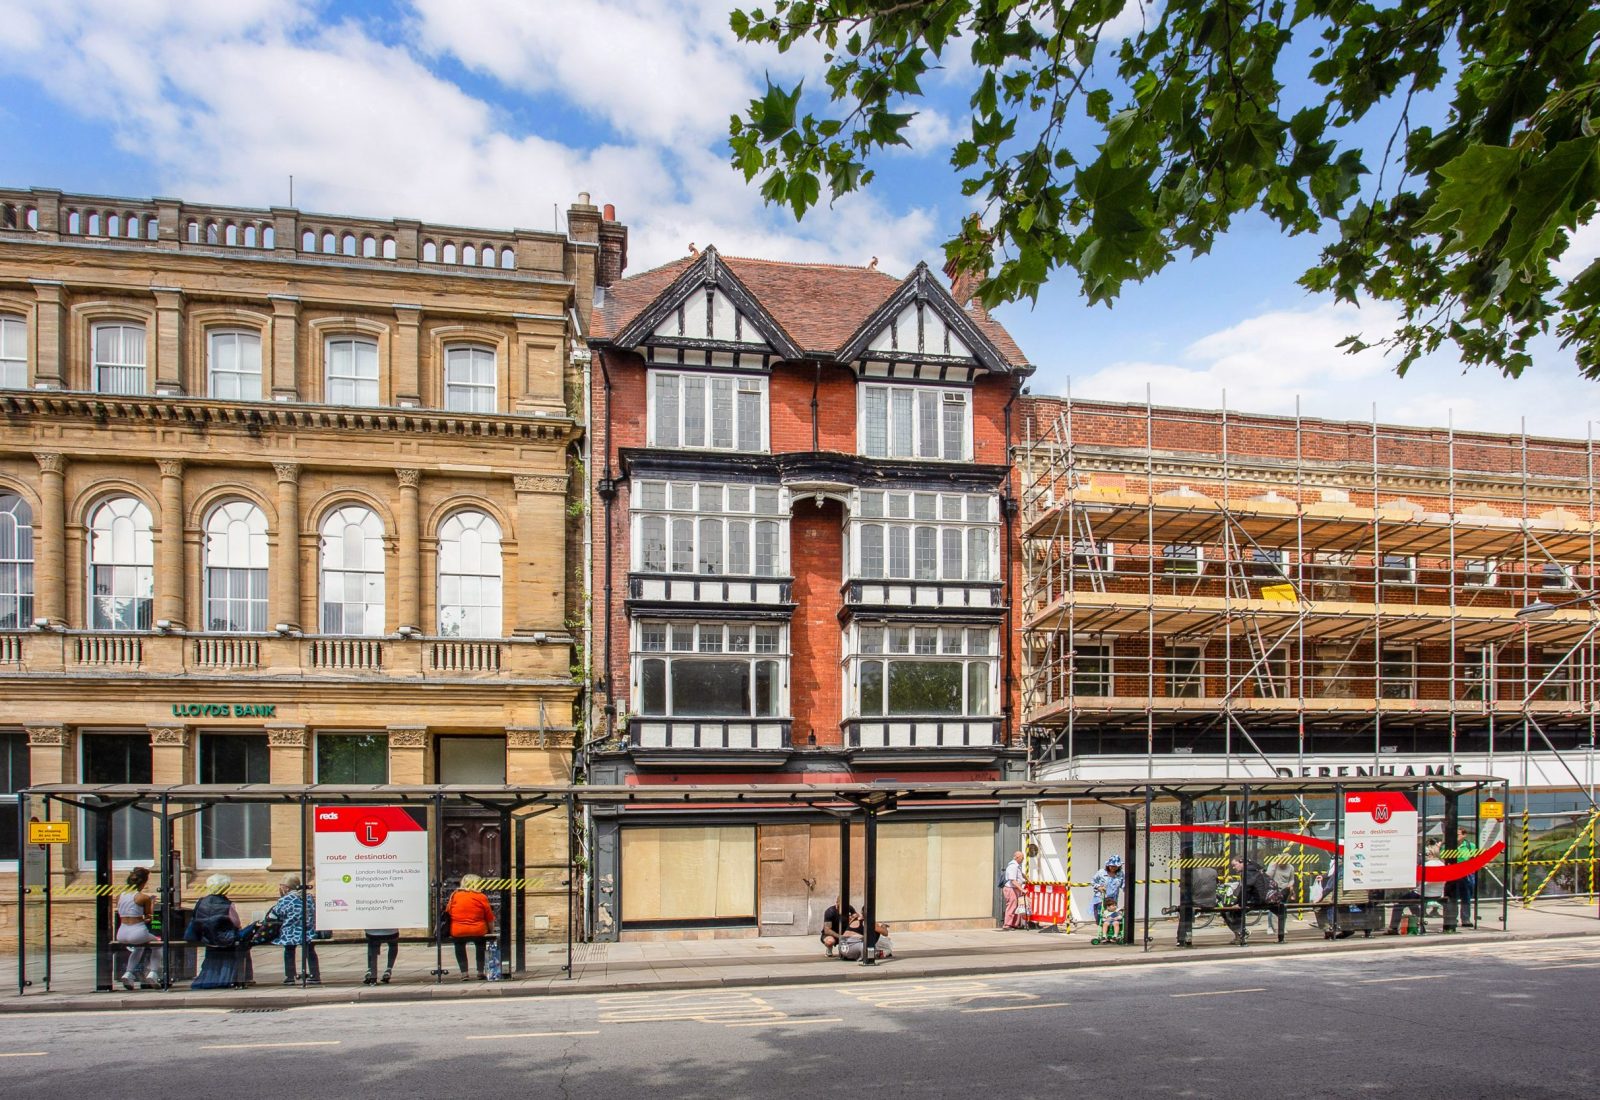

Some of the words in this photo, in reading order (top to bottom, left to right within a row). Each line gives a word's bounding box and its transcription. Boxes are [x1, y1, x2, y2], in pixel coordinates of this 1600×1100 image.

[172, 704, 230, 717] LLOYDS
[233, 704, 276, 717] BANK
[1276, 765, 1462, 777] DEBENHAMS
[320, 812, 338, 820] reds
[1375, 806, 1388, 820] M
[366, 826, 378, 842] L
[595, 992, 788, 1024] STOP
